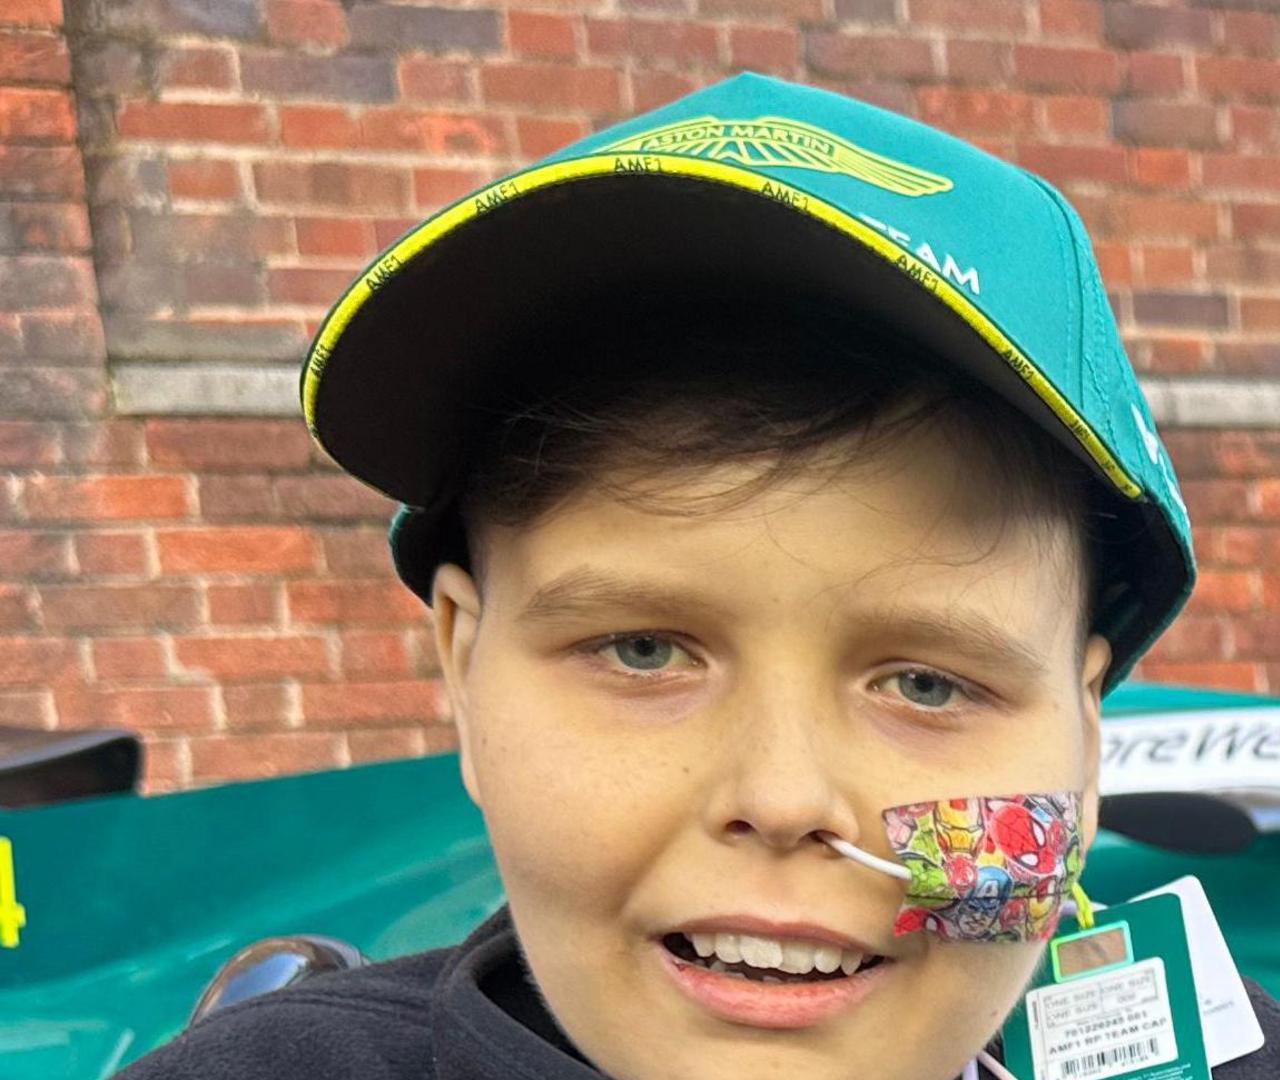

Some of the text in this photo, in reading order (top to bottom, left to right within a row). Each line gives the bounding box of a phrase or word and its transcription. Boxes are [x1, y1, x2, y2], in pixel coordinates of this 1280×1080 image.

[643, 124, 832, 155] ASTON MARTIN
[614, 156, 662, 173] AMF1
[474, 181, 524, 214] AMF1
[761, 180, 810, 212] AMF1
[365, 254, 402, 291] AMF1
[897, 253, 939, 292] AMF1
[1104, 1022, 1140, 1040] TEAM
[1143, 1016, 1168, 1032] CAP
